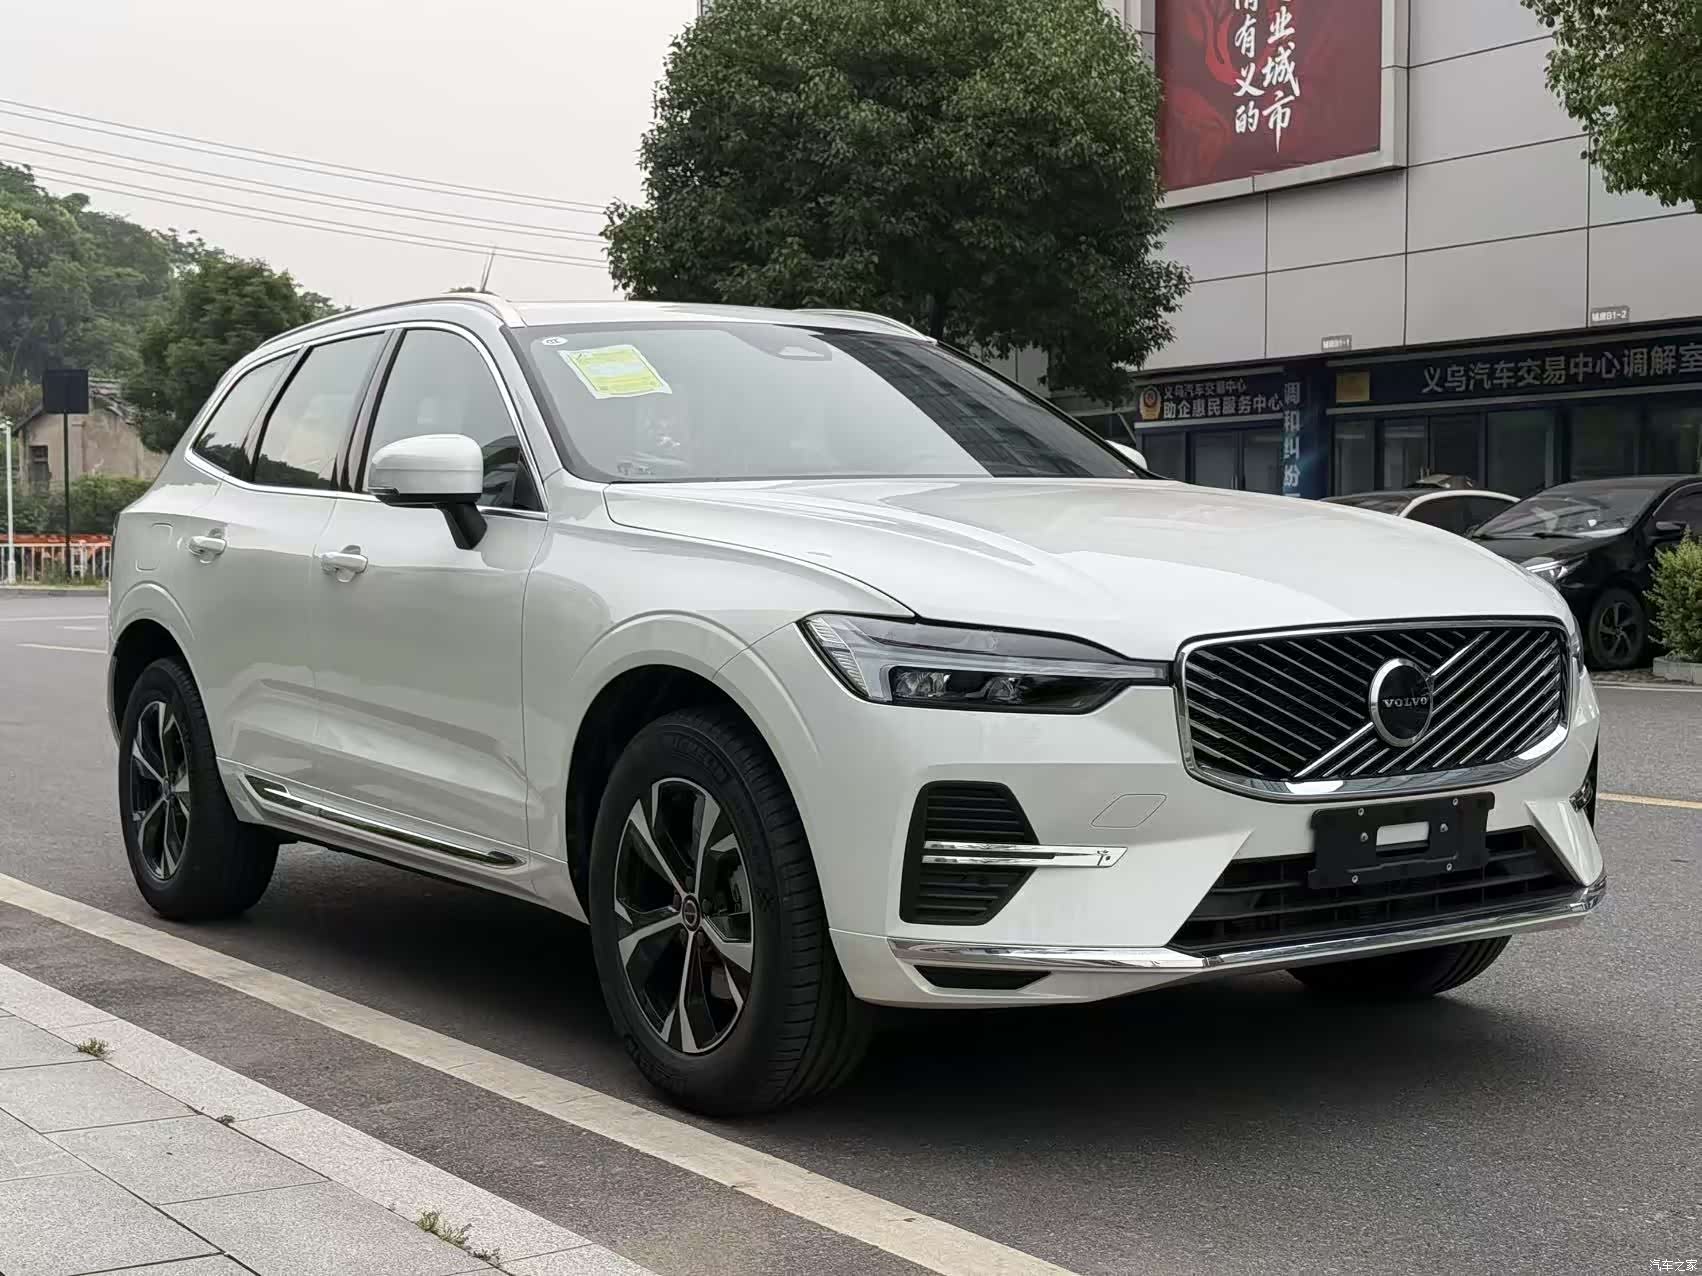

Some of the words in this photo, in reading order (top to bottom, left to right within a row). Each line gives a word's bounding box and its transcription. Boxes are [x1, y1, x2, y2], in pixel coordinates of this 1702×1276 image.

[1262, 0, 1300, 152] 业城市
[1422, 343, 1702, 393] 义乌汽车交易中心调解室
[1163, 394, 1284, 418] 助企惠民服务中心
[1284, 382, 1301, 497] 调和纠纷
[1382, 697, 1427, 708] VOLVO
